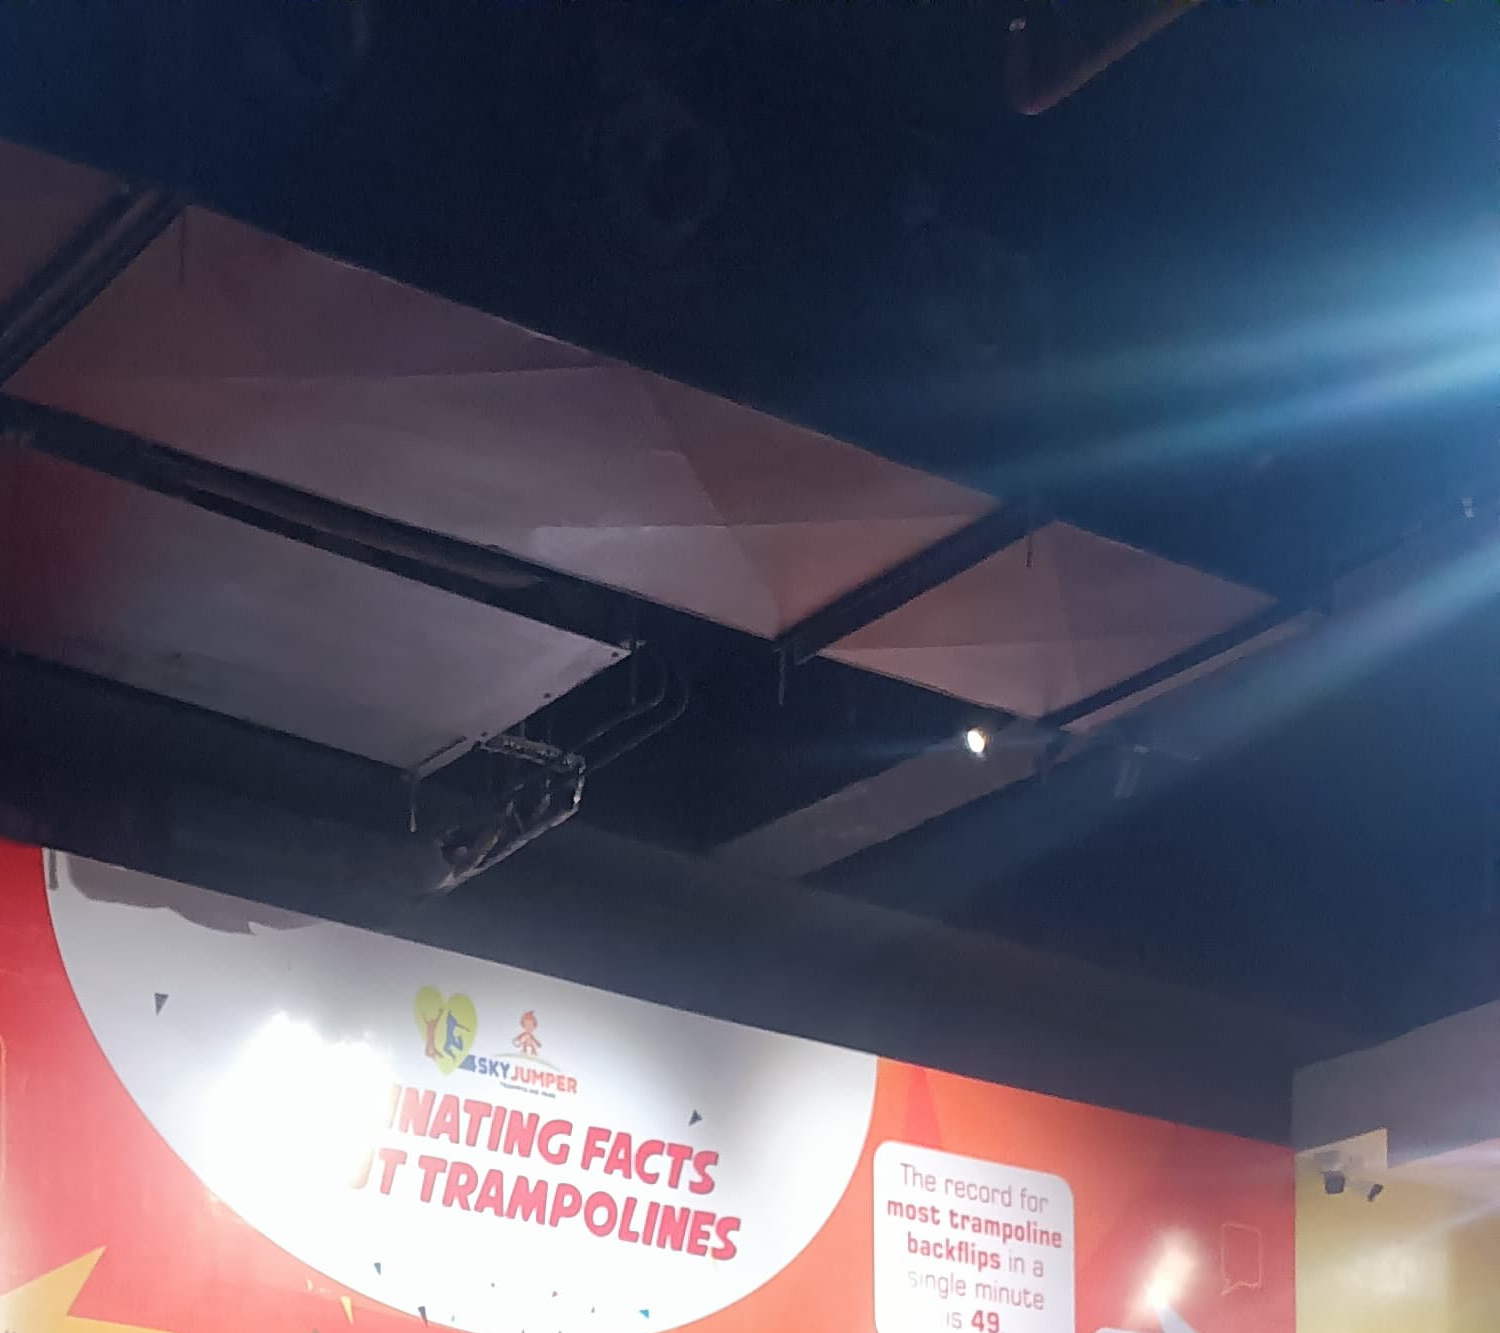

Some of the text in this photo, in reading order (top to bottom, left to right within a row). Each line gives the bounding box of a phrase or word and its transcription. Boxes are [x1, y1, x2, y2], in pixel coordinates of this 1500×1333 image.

[581, 1127, 719, 1195] FACTS
[417, 1155, 741, 1260] TRAMPOLINES
[900, 1163, 1049, 1213] The record for
[887, 1200, 1062, 1248] most trampoline
[907, 1232, 1044, 1277] backflips in a
[976, 1281, 1044, 1310] minute
